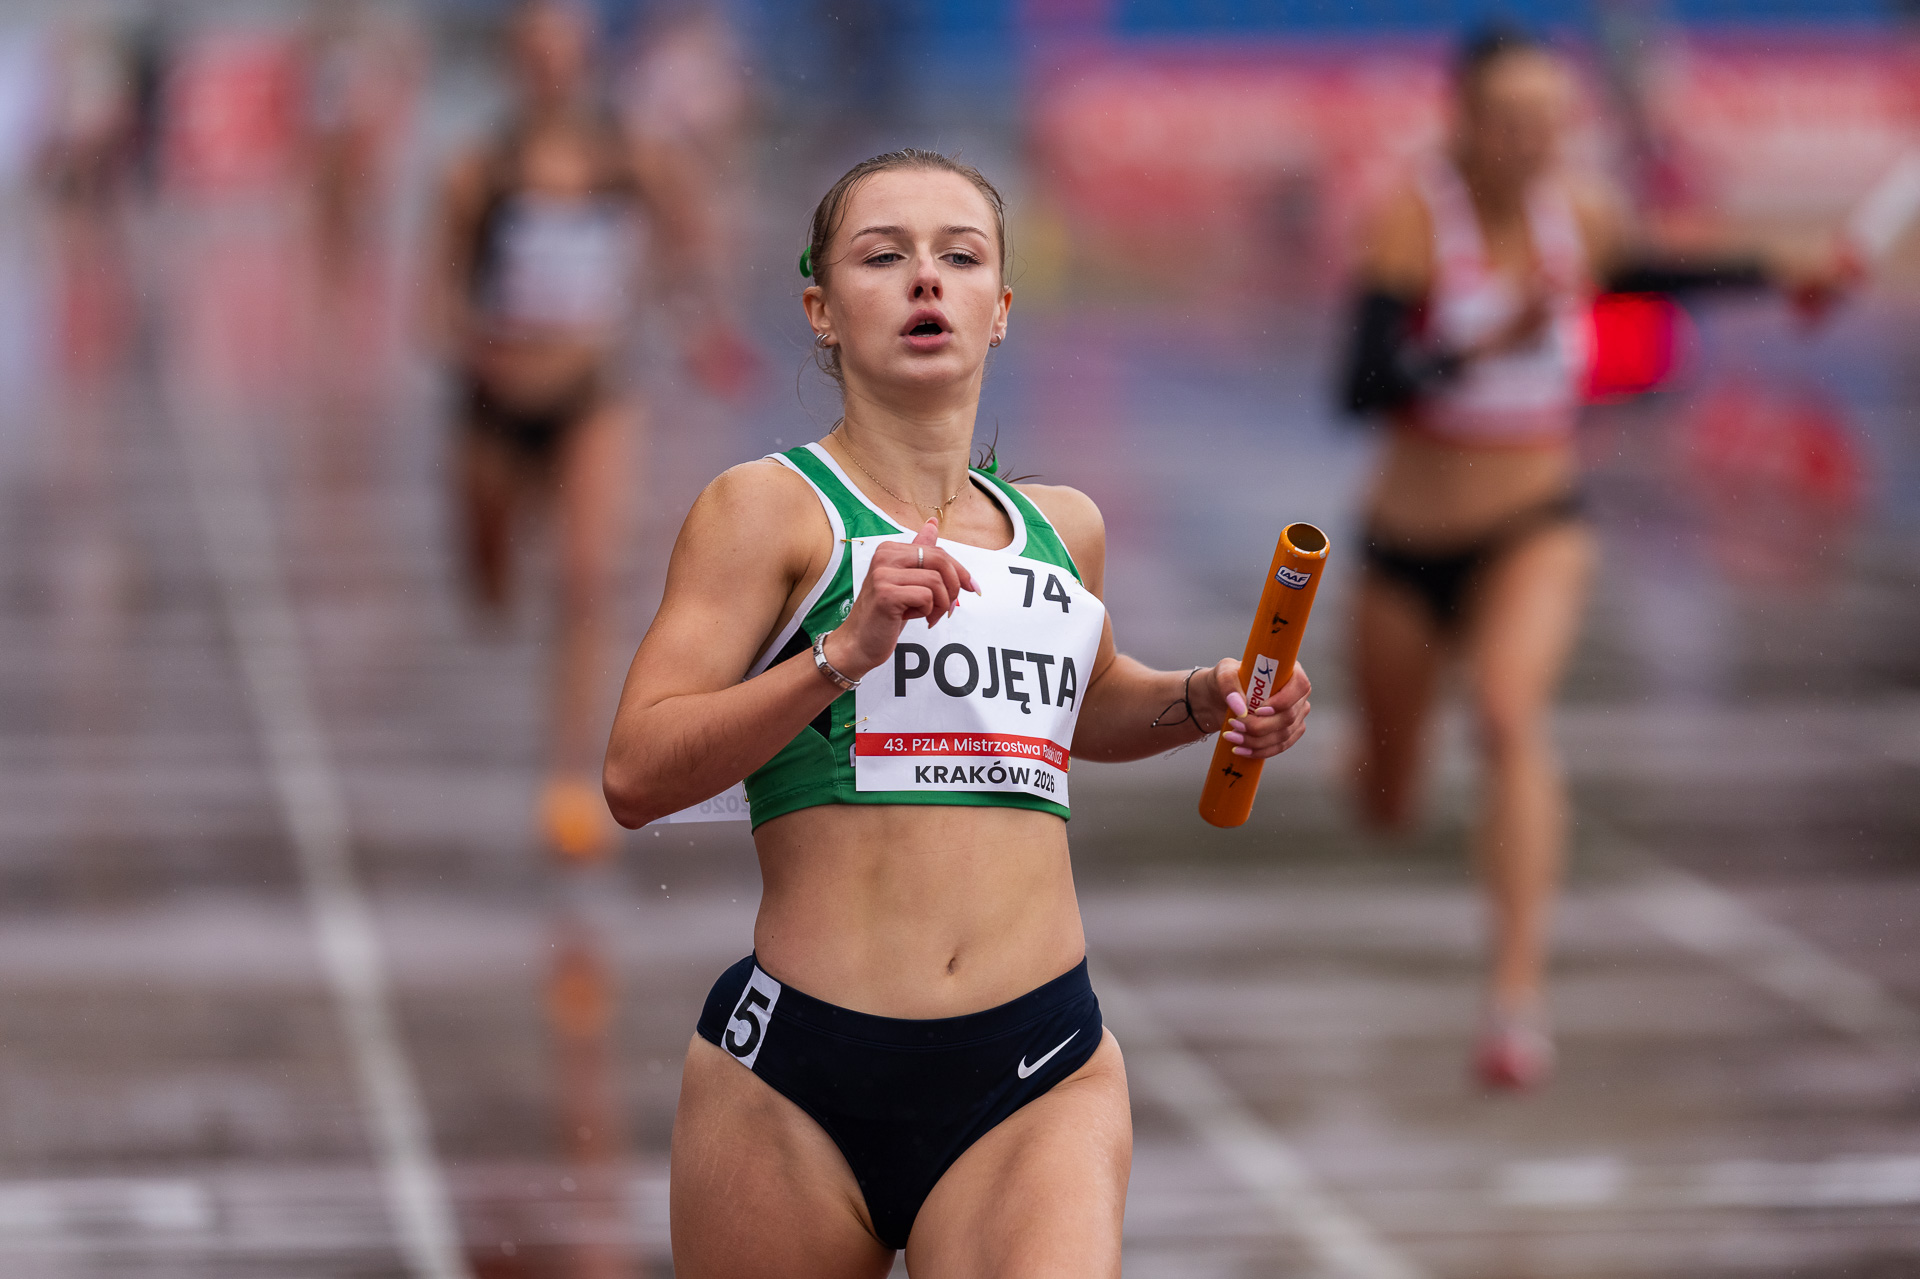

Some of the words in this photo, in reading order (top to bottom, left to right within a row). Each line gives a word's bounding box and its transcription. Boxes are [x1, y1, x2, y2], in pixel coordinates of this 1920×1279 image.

[1008, 566, 1071, 614] 74
[1280, 569, 1307, 582] IAAF
[894, 643, 1077, 715] POJĘTA
[883, 738, 908, 752] 43.
[912, 739, 950, 752] PZLA
[954, 738, 1041, 756] Mistrzostwa
[915, 760, 1030, 784] KRAKÓW
[1034, 769, 1055, 793] 2026
[725, 986, 771, 1058] 5
